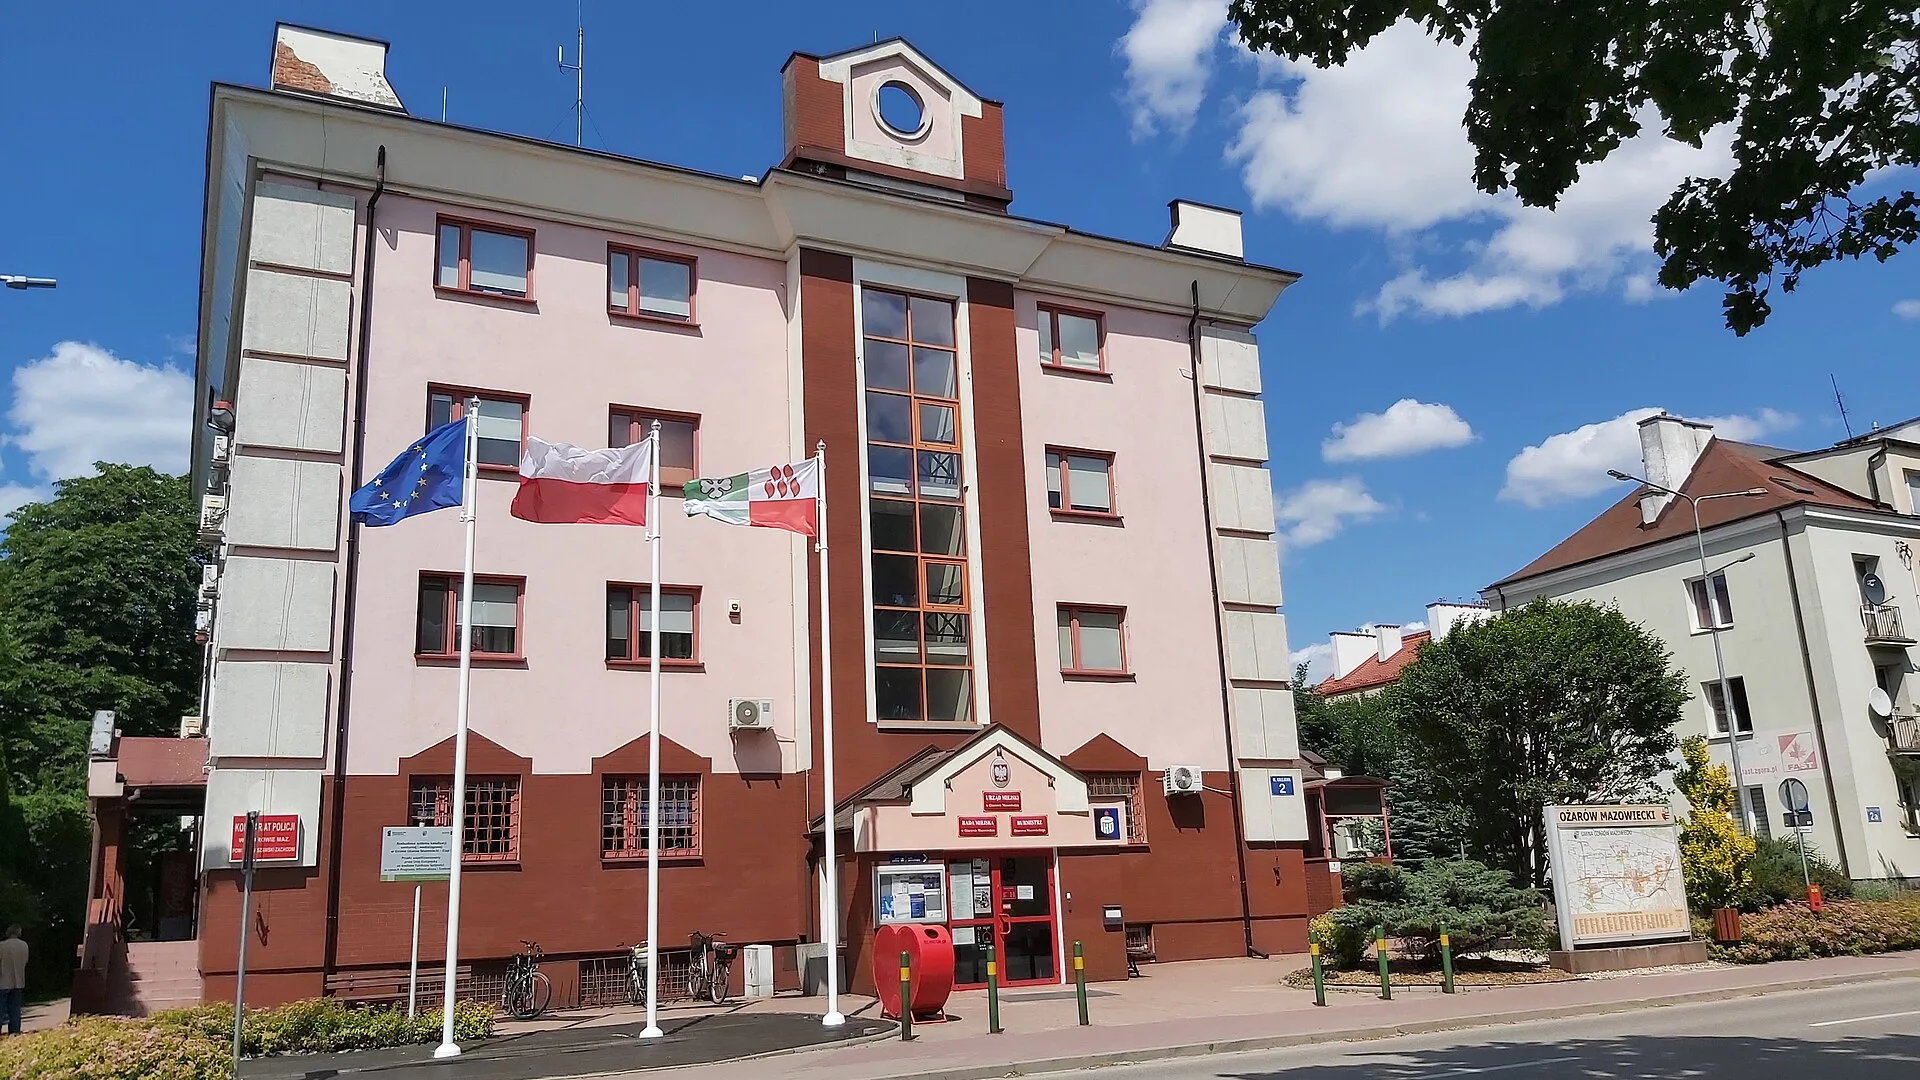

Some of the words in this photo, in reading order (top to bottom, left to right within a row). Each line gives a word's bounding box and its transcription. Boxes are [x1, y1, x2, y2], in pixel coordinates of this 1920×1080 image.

[1788, 762, 1814, 771] FAST
[1279, 783, 1287, 794] 2
[1559, 809, 1598, 821] OŻARÓW
[1600, 810, 1656, 821] MAZOWIECKI
[1869, 811, 1879, 821] 2a
[234, 822, 272, 832] KORAT
[272, 822, 296, 832] POLICJI
